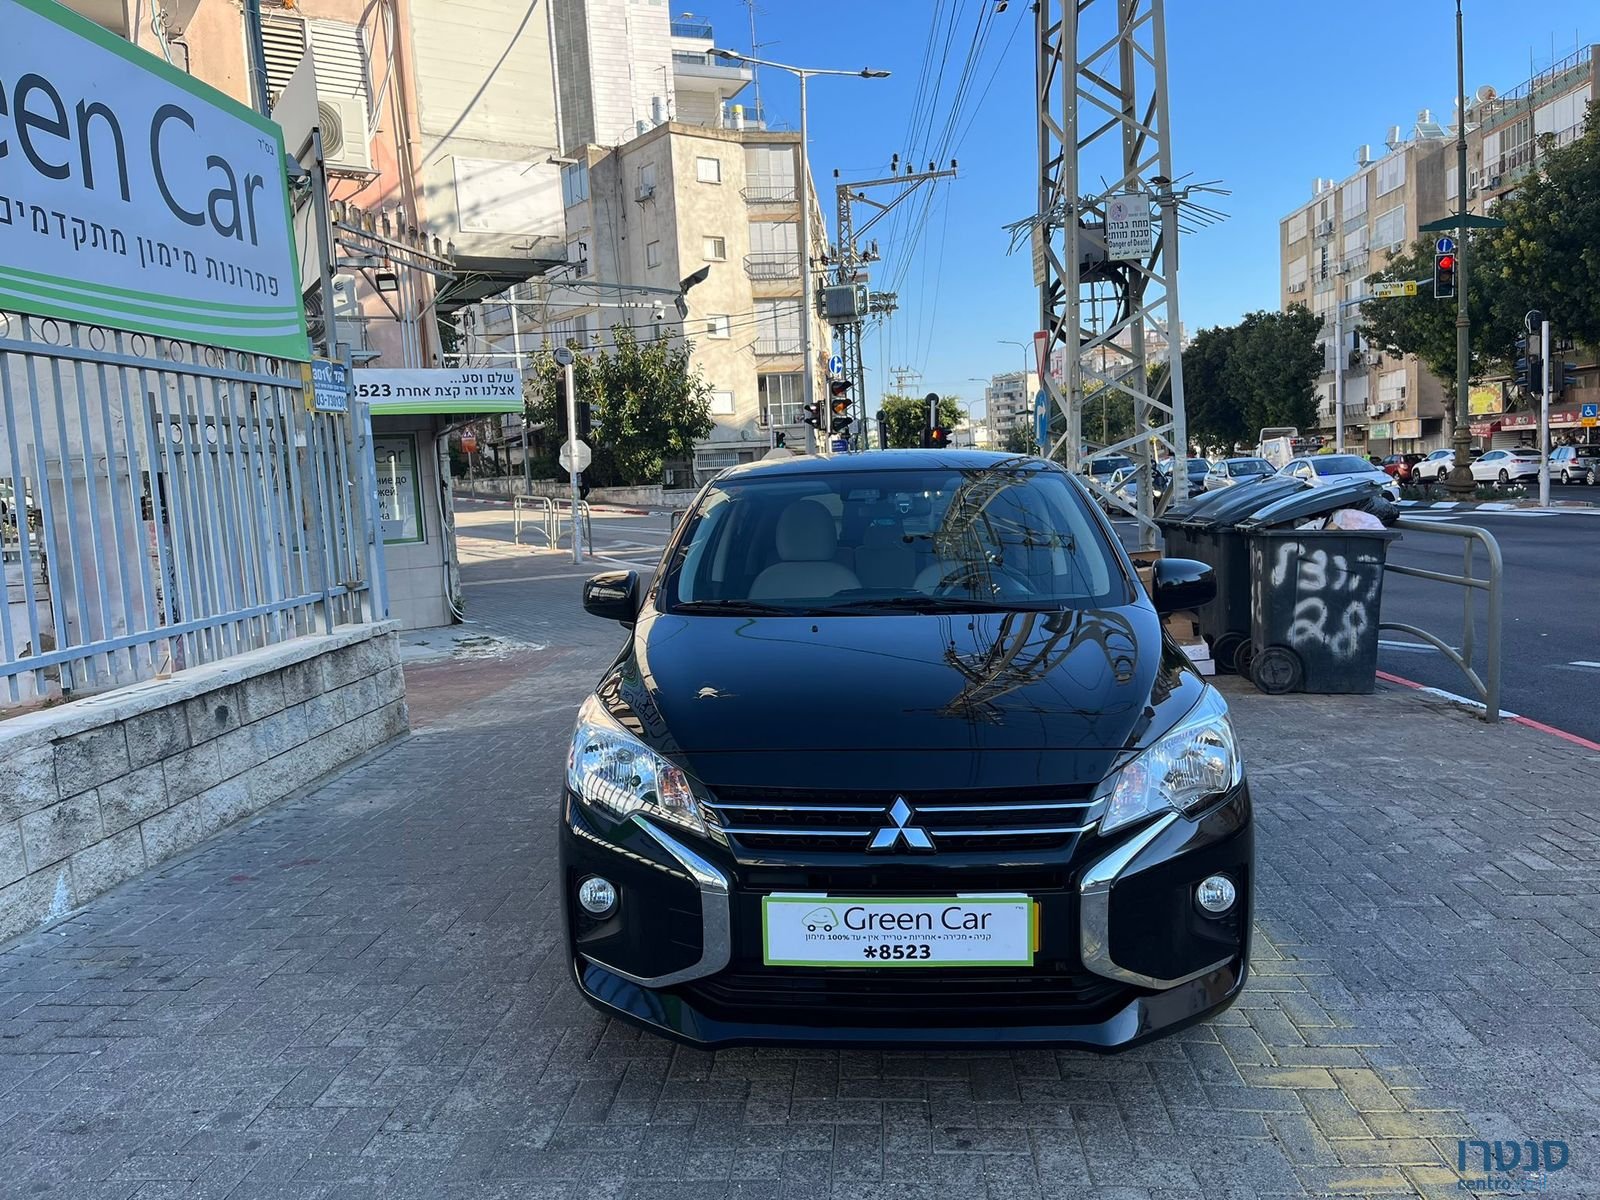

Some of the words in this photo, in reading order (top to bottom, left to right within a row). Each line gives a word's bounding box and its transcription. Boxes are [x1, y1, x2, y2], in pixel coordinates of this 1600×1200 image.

[0, 73, 131, 203] en
[150, 103, 265, 247] Car
[0, 195, 127, 256] מתקדמים
[1132, 219, 1149, 229] מתח
[1130, 229, 1149, 238] סכנת
[1108, 240, 1127, 249] Danger
[136, 235, 197, 275] מימון
[205, 256, 280, 298] פתרונות
[1406, 284, 1414, 292] 13
[450, 373, 483, 384] וסע...
[487, 372, 514, 384] שלם
[396, 386, 430, 397] אחרת
[435, 386, 461, 399] קצת
[465, 386, 478, 396] זה
[482, 384, 515, 396] אצלנו
[374, 446, 405, 464] Car
[843, 906, 933, 931] Green
[941, 906, 992, 931] Car
[805, 934, 826, 942] מימון
[868, 933, 880, 942] אין
[882, 933, 903, 941] טרייד
[909, 933, 937, 941] אחריות
[943, 933, 967, 941] מכירה
[974, 933, 992, 941] קניה
